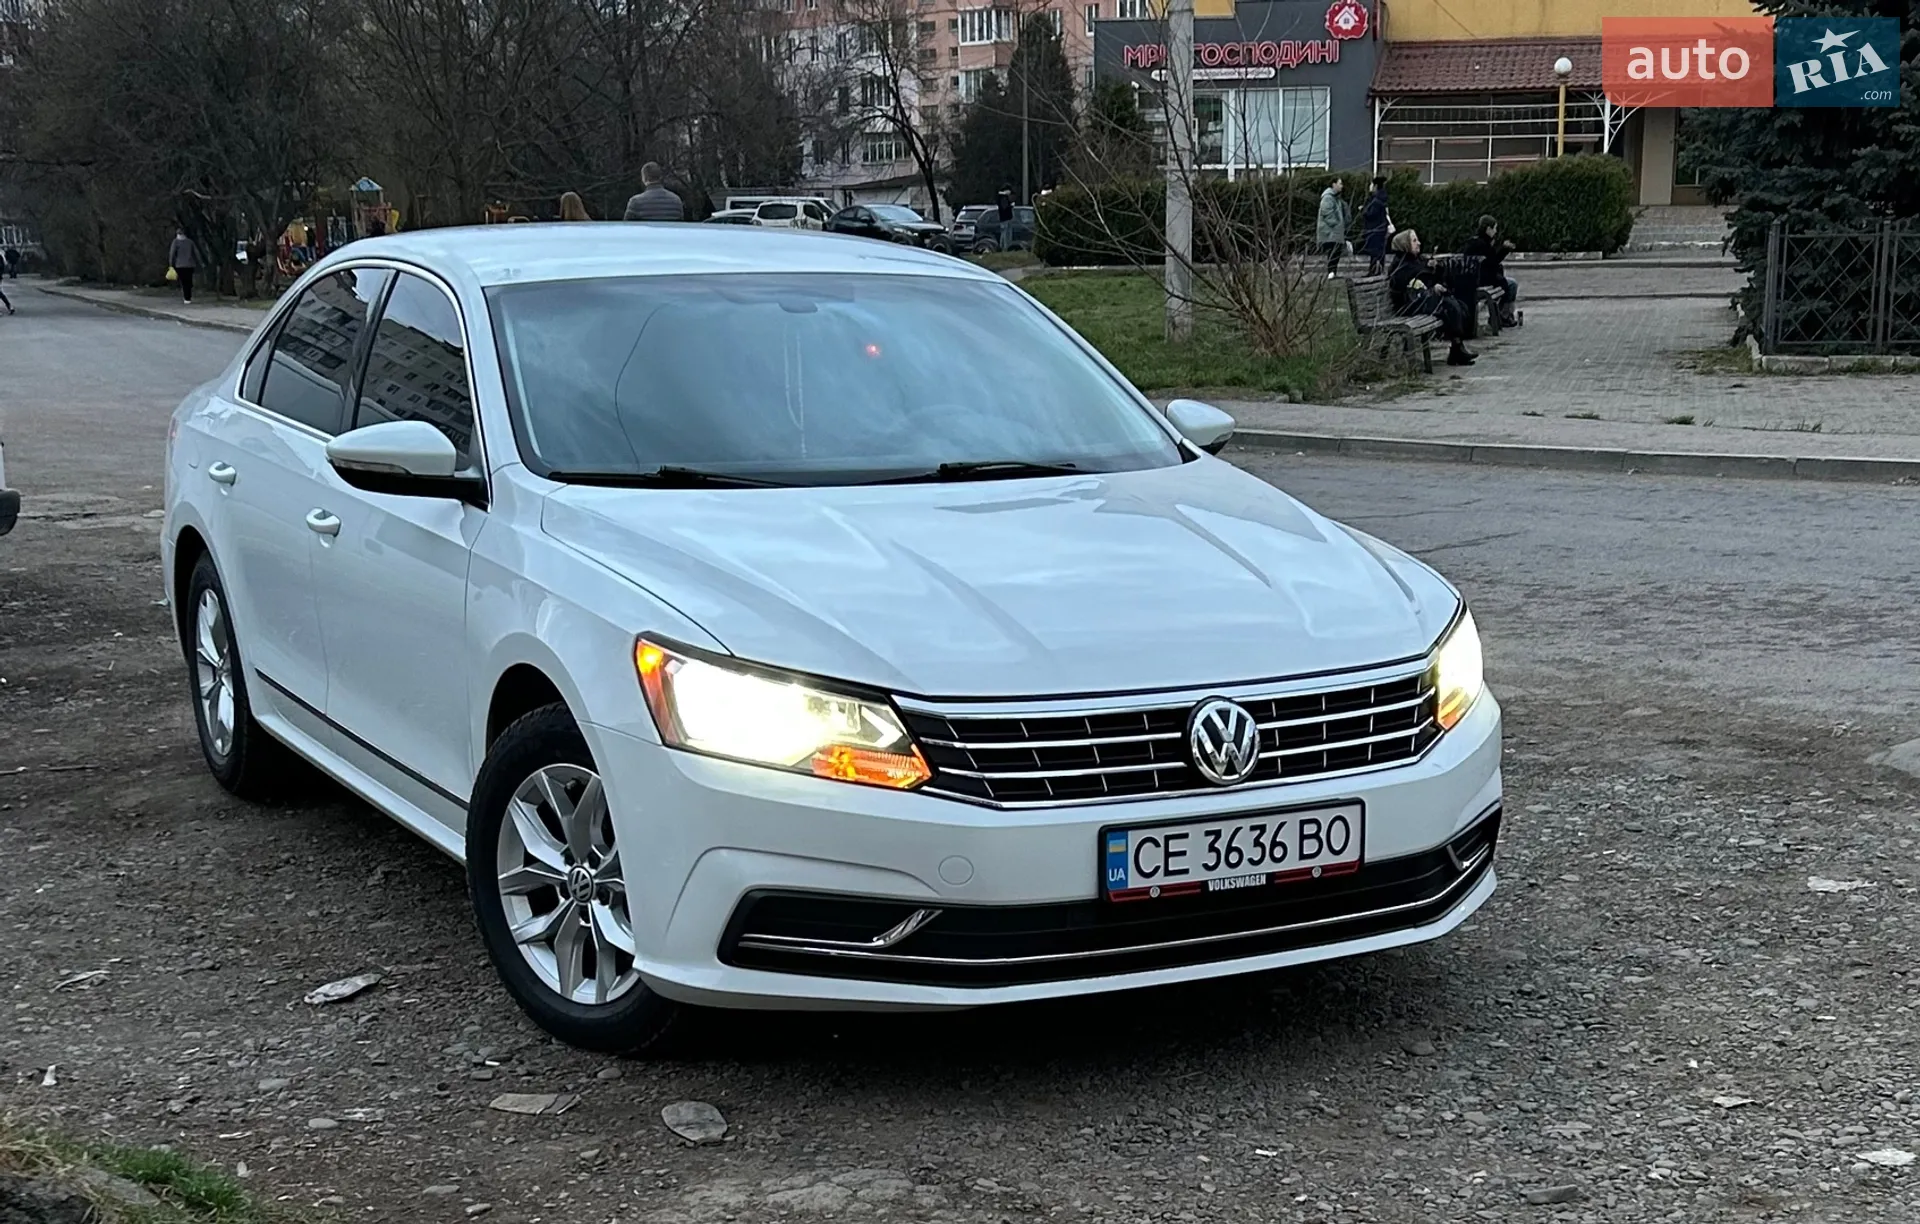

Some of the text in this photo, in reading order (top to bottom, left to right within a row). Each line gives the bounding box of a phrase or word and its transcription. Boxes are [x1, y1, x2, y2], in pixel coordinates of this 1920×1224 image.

[1124, 43, 1167, 68] МРІ
[1133, 814, 1351, 879] CE 3636 BO
[1108, 867, 1126, 882] UA
[1208, 873, 1267, 892] VOLKSWAGEN
